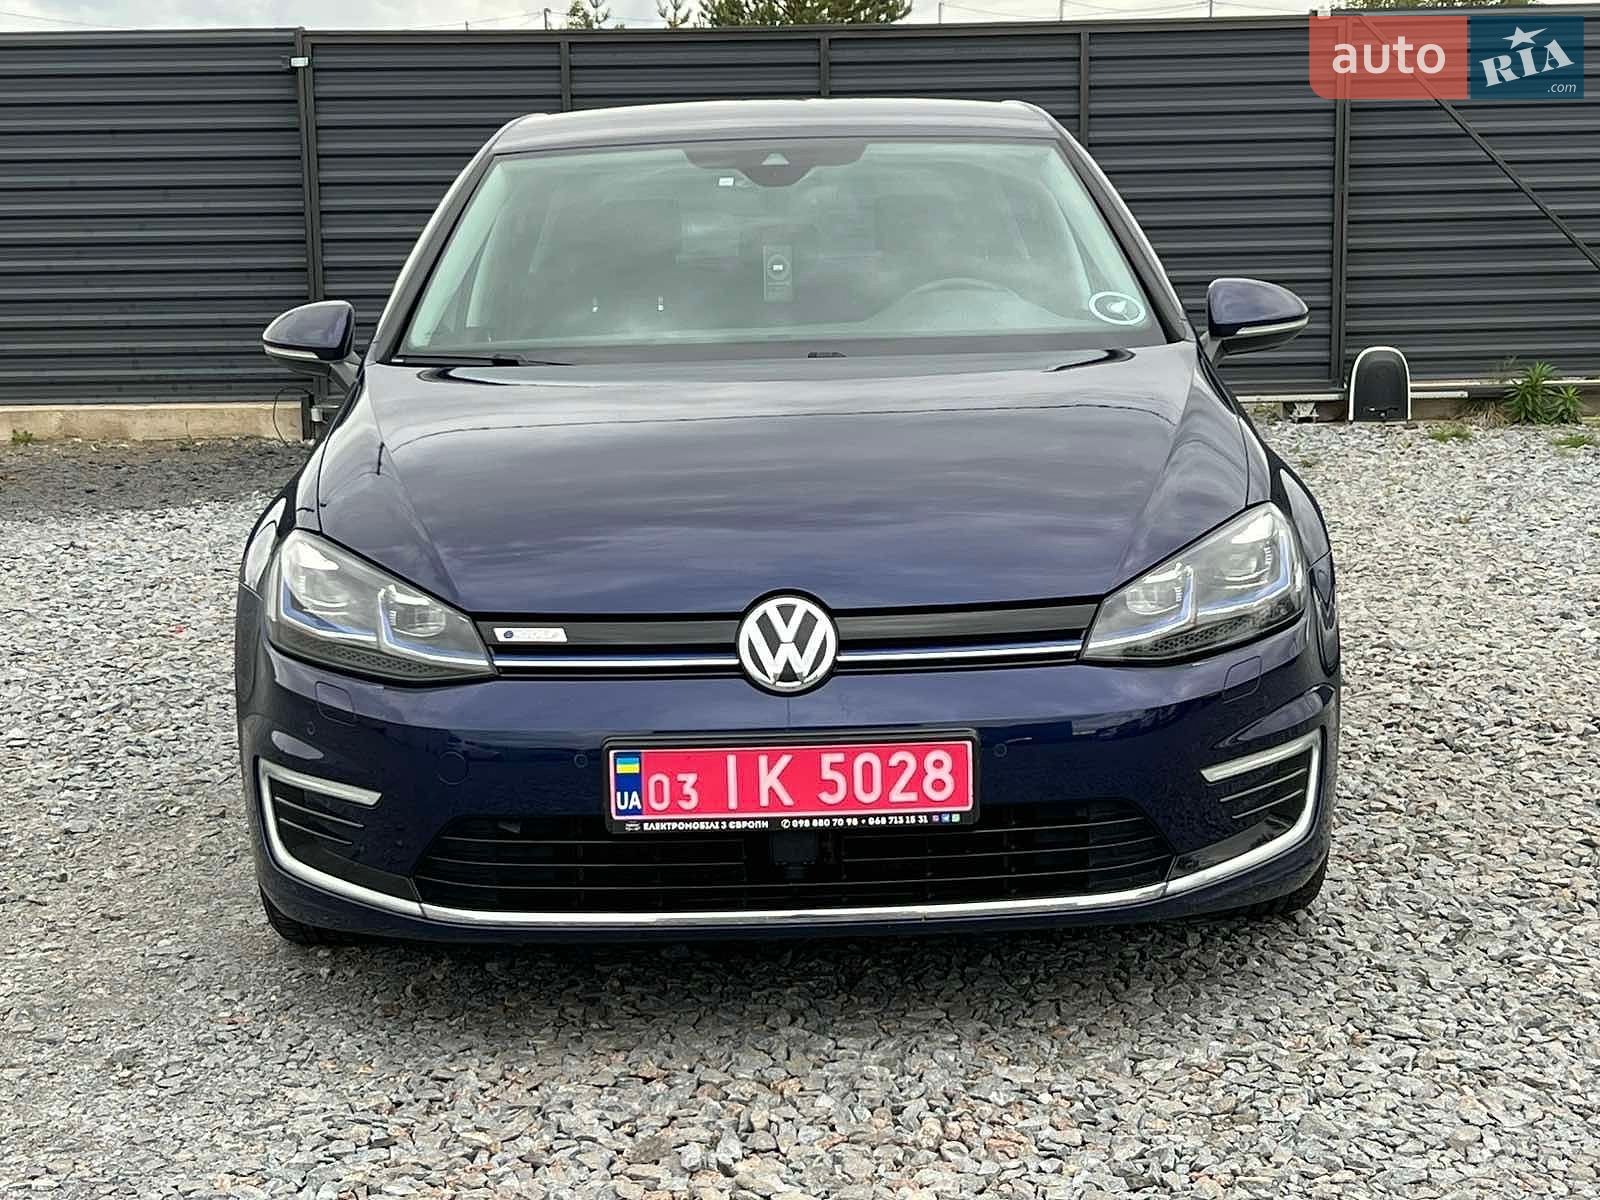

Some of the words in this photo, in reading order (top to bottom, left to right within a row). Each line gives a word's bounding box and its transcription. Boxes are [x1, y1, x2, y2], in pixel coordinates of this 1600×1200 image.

[648, 773, 700, 812] 03
[817, 749, 955, 805] 5028
[616, 791, 641, 810] UA
[791, 819, 810, 828] 098
[832, 818, 844, 827] 70
[917, 815, 928, 824] 31
